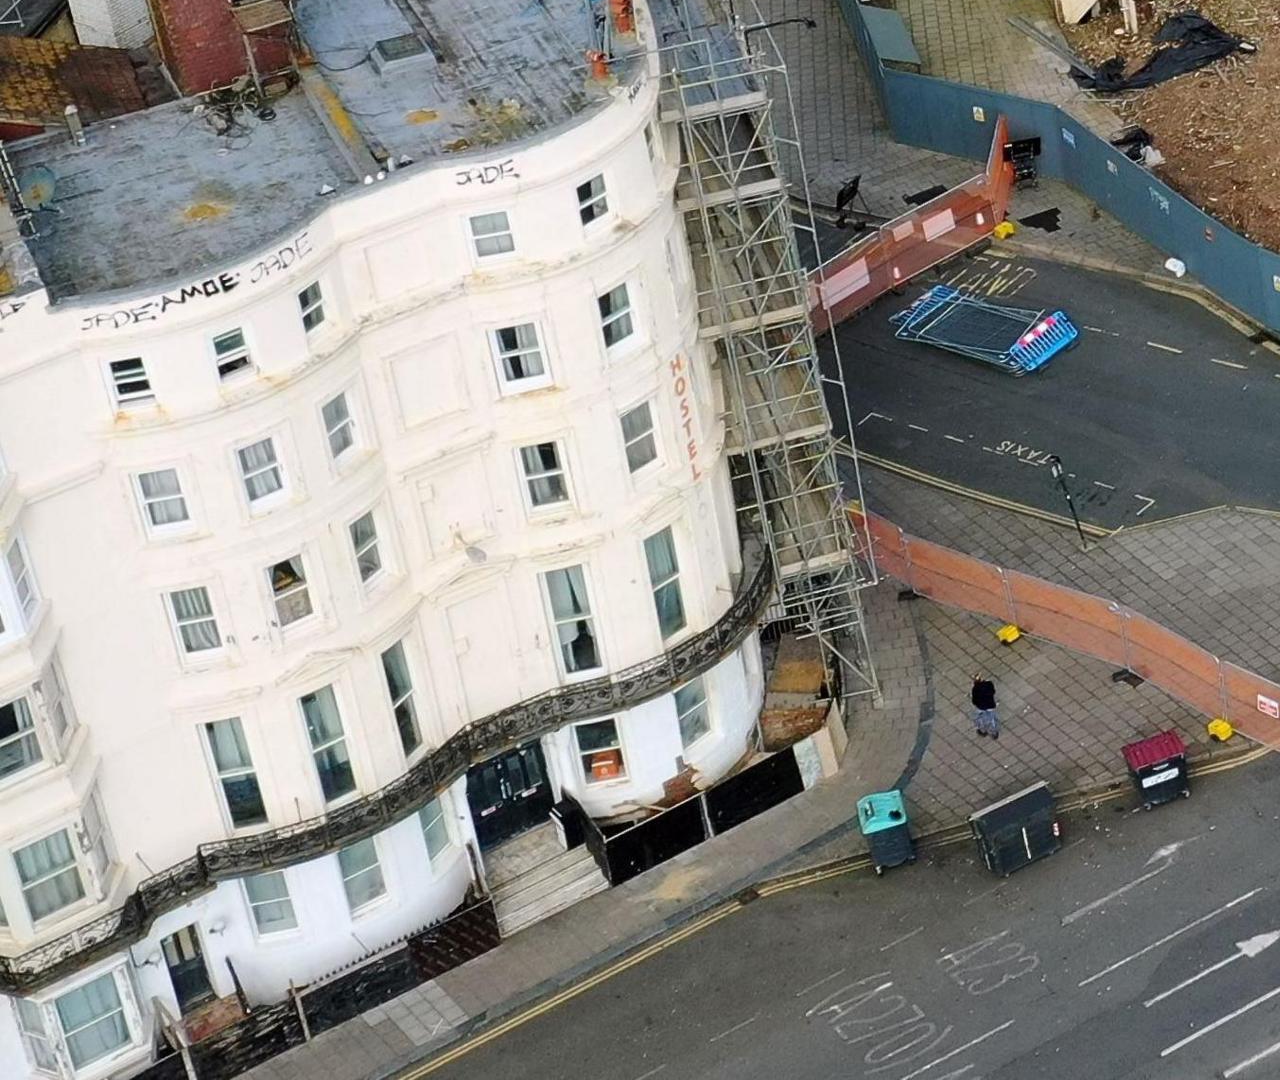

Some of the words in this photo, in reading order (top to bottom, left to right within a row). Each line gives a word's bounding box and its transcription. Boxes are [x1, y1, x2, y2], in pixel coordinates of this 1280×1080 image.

[456, 159, 521, 185] JADE
[251, 232, 312, 283] JADE
[81, 302, 154, 329] JADE
[670, 354, 702, 481] HOSTEL
[996, 441, 1053, 465] TAXIS
[936, 930, 1040, 996] A23
